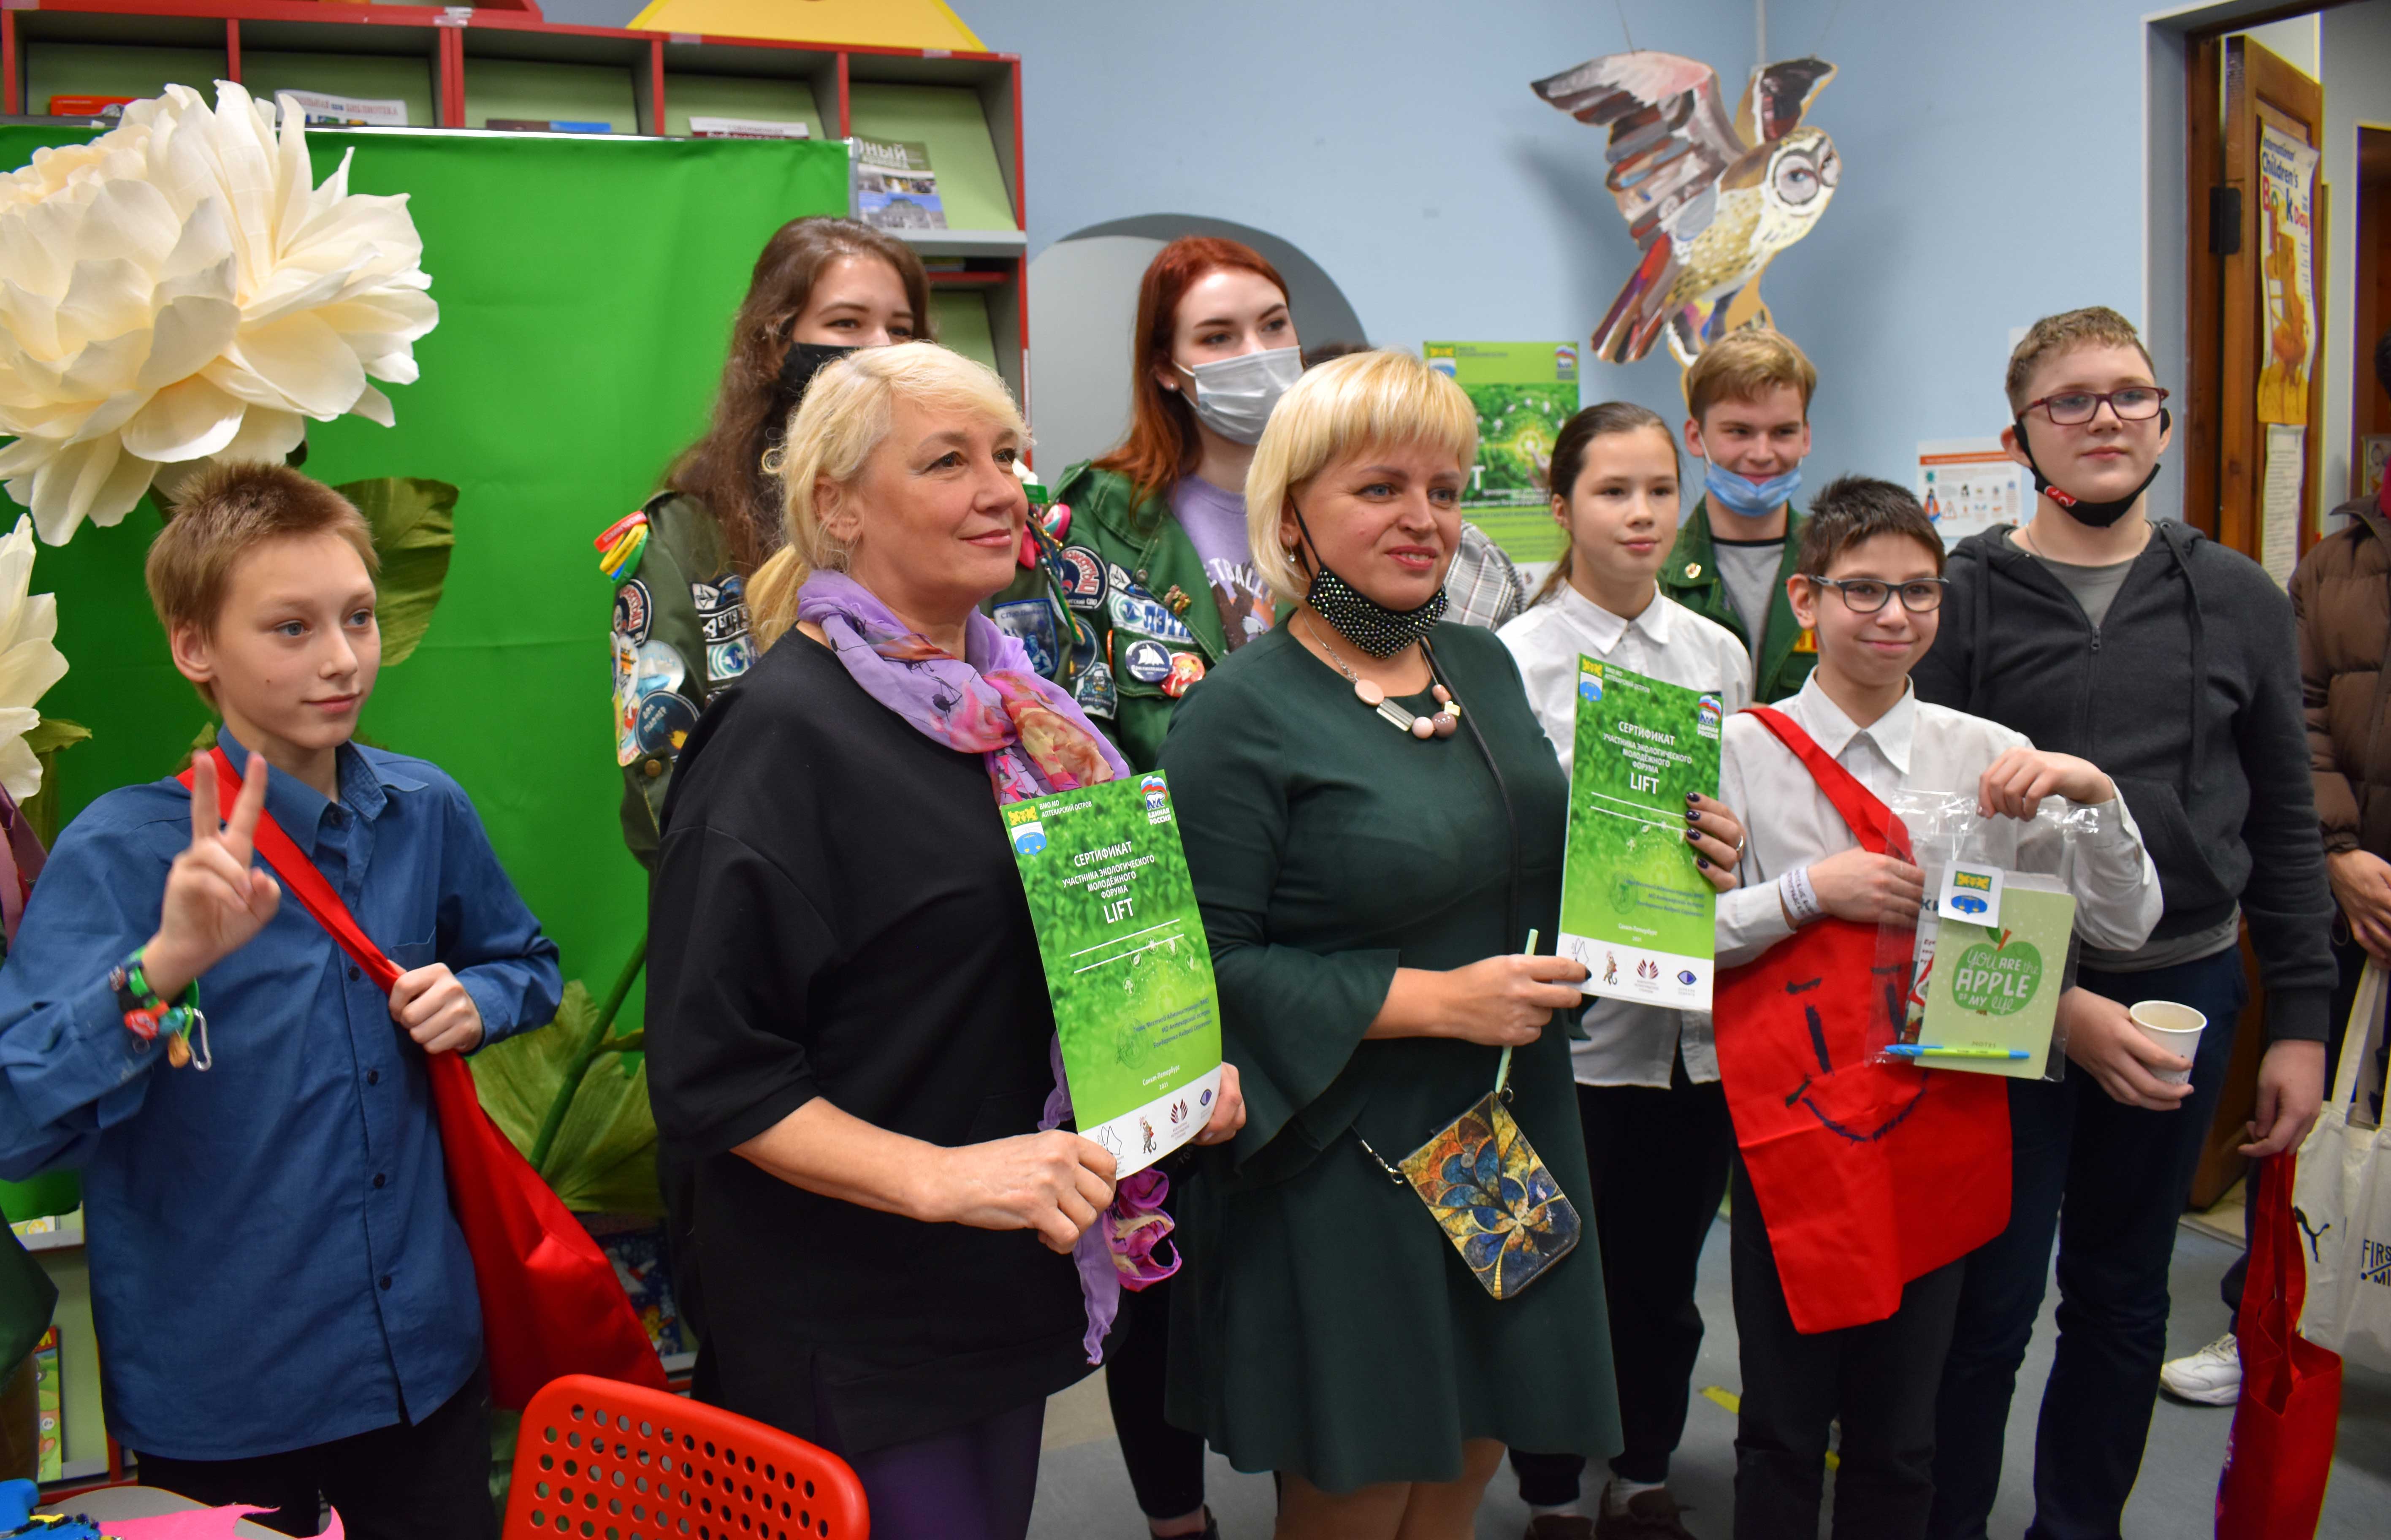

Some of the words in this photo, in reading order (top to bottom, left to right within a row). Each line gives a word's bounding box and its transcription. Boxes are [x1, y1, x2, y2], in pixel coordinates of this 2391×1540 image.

[1618, 721, 1675, 746] СЕРТИФИКАТ
[1603, 733, 1636, 749] УЧАСТНИКА
[1637, 742, 1692, 765] ЭКОЛОГИЧЕСКОГО
[1632, 761, 1659, 774] ФОРУМА
[1630, 772, 1659, 795] LIFT
[1039, 802, 1051, 810] ВМО
[1052, 800, 1060, 808] МО
[1041, 803, 1074, 818] АПТЕКАРСКИЙ
[1074, 800, 1092, 811] ОСТРОВ
[1147, 807, 1170, 818] ЕДИНАЯ
[1149, 813, 1171, 826] РОССИЯ
[1074, 841, 1132, 867] СЕРТИФИКАТ
[1062, 871, 1098, 888] УЧАСТНИКА
[1098, 854, 1155, 877] ЭКОЛОГИЧЕСКОГО
[1087, 871, 1136, 892] МОЛОДЁЖНОГО
[1101, 884, 1128, 899] ФОРУМА
[1103, 898, 1134, 924] LIFT
[1998, 957, 2021, 971] ARE
[2023, 961, 2039, 975] the
[1955, 968, 2031, 998] APPLE
[1968, 995, 1987, 1007] MY
[1972, 1040, 1996, 1049] NOTES
[1142, 1063, 1180, 1087] Санкт-Петербург
[1159, 1082, 1169, 1090] 2021
